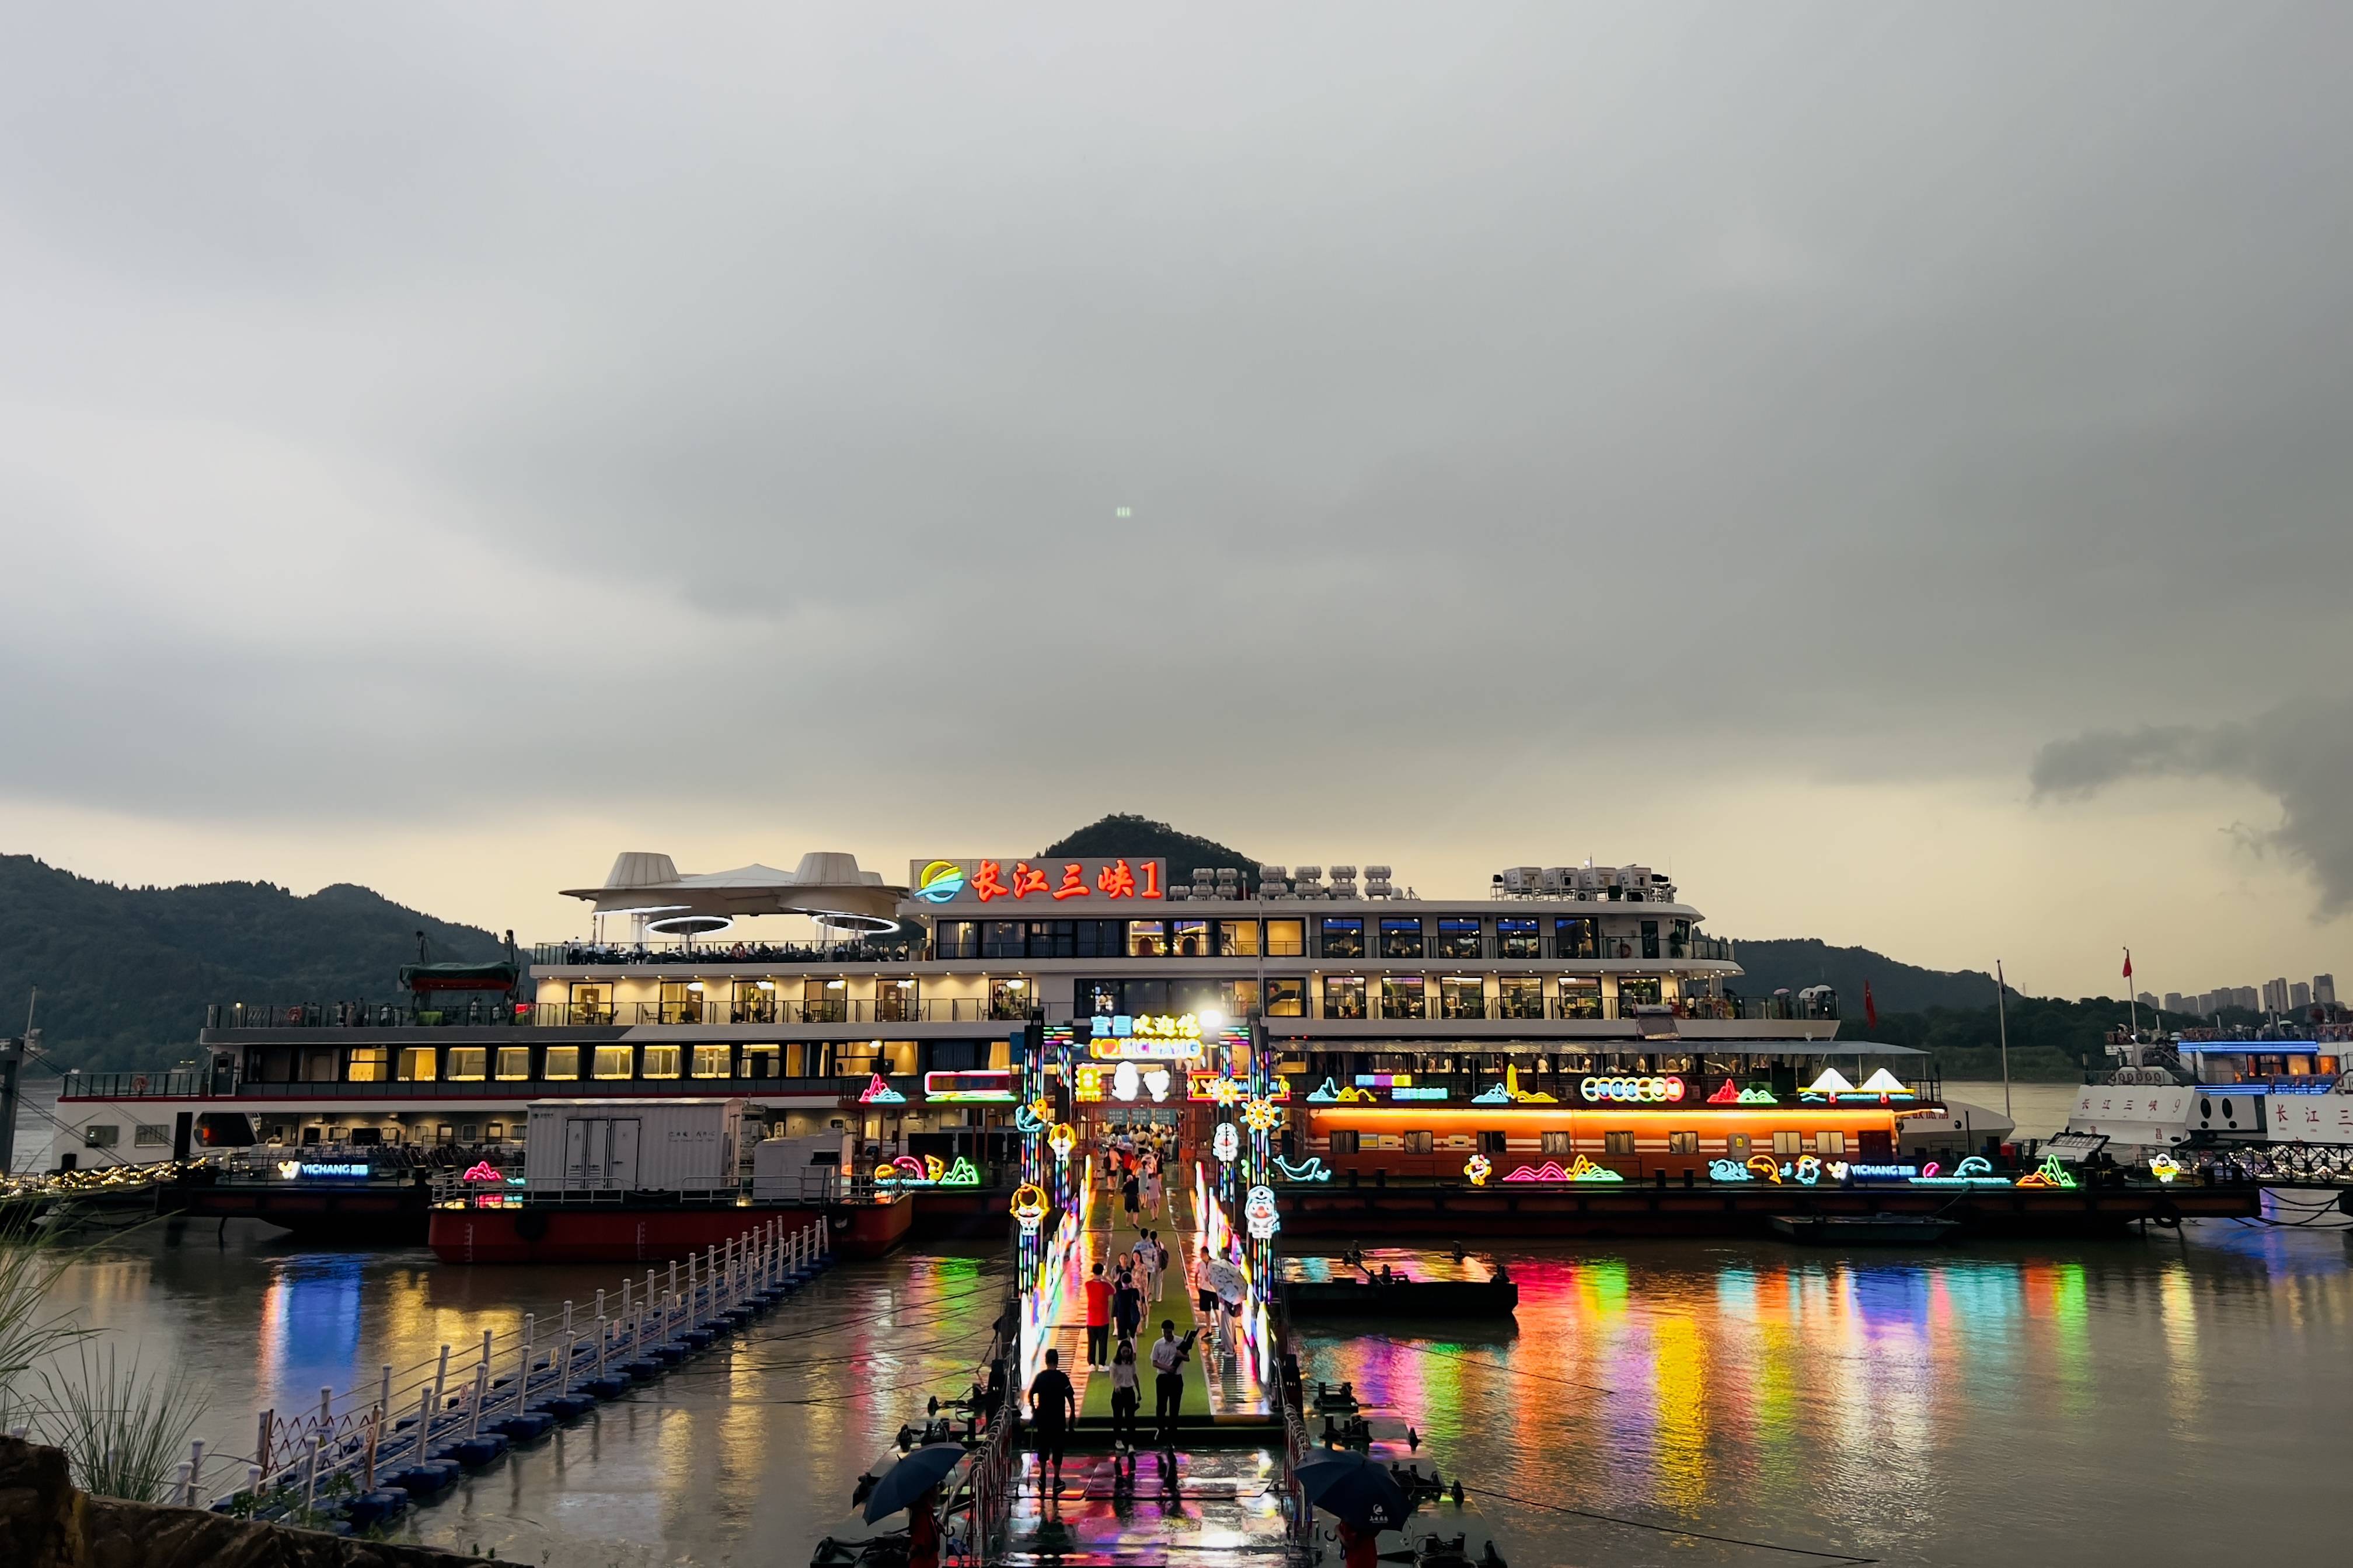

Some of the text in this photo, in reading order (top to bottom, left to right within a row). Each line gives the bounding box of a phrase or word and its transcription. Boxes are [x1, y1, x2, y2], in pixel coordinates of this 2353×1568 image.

[971, 859, 1161, 902] 长江三峡1
[1090, 1013, 1201, 1038] 宜昌欢迎您
[1119, 1038, 1202, 1059] YICHANG
[301, 1164, 350, 1175] YICHANG
[1850, 1165, 1898, 1175] YICHANG
